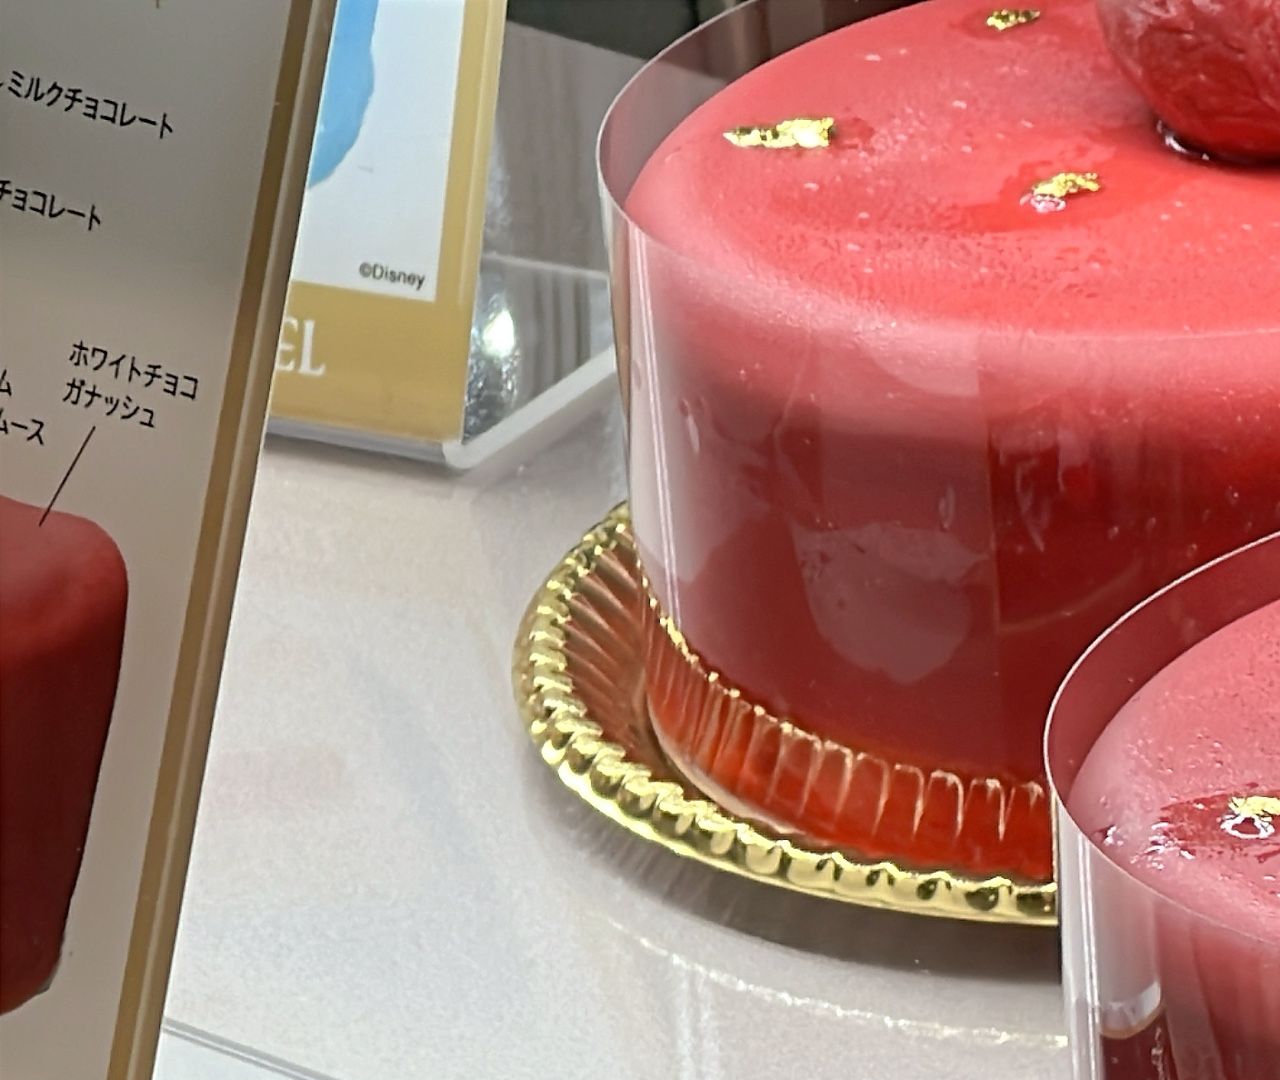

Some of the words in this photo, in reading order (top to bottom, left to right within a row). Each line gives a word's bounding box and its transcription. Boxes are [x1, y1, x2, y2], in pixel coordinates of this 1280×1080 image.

[0, 70, 173, 139] ミルクチョコレート
[359, 262, 426, 291] ©Disney
[69, 340, 198, 400] ホワイトチョコ
[62, 377, 155, 429] ガナッシュ
